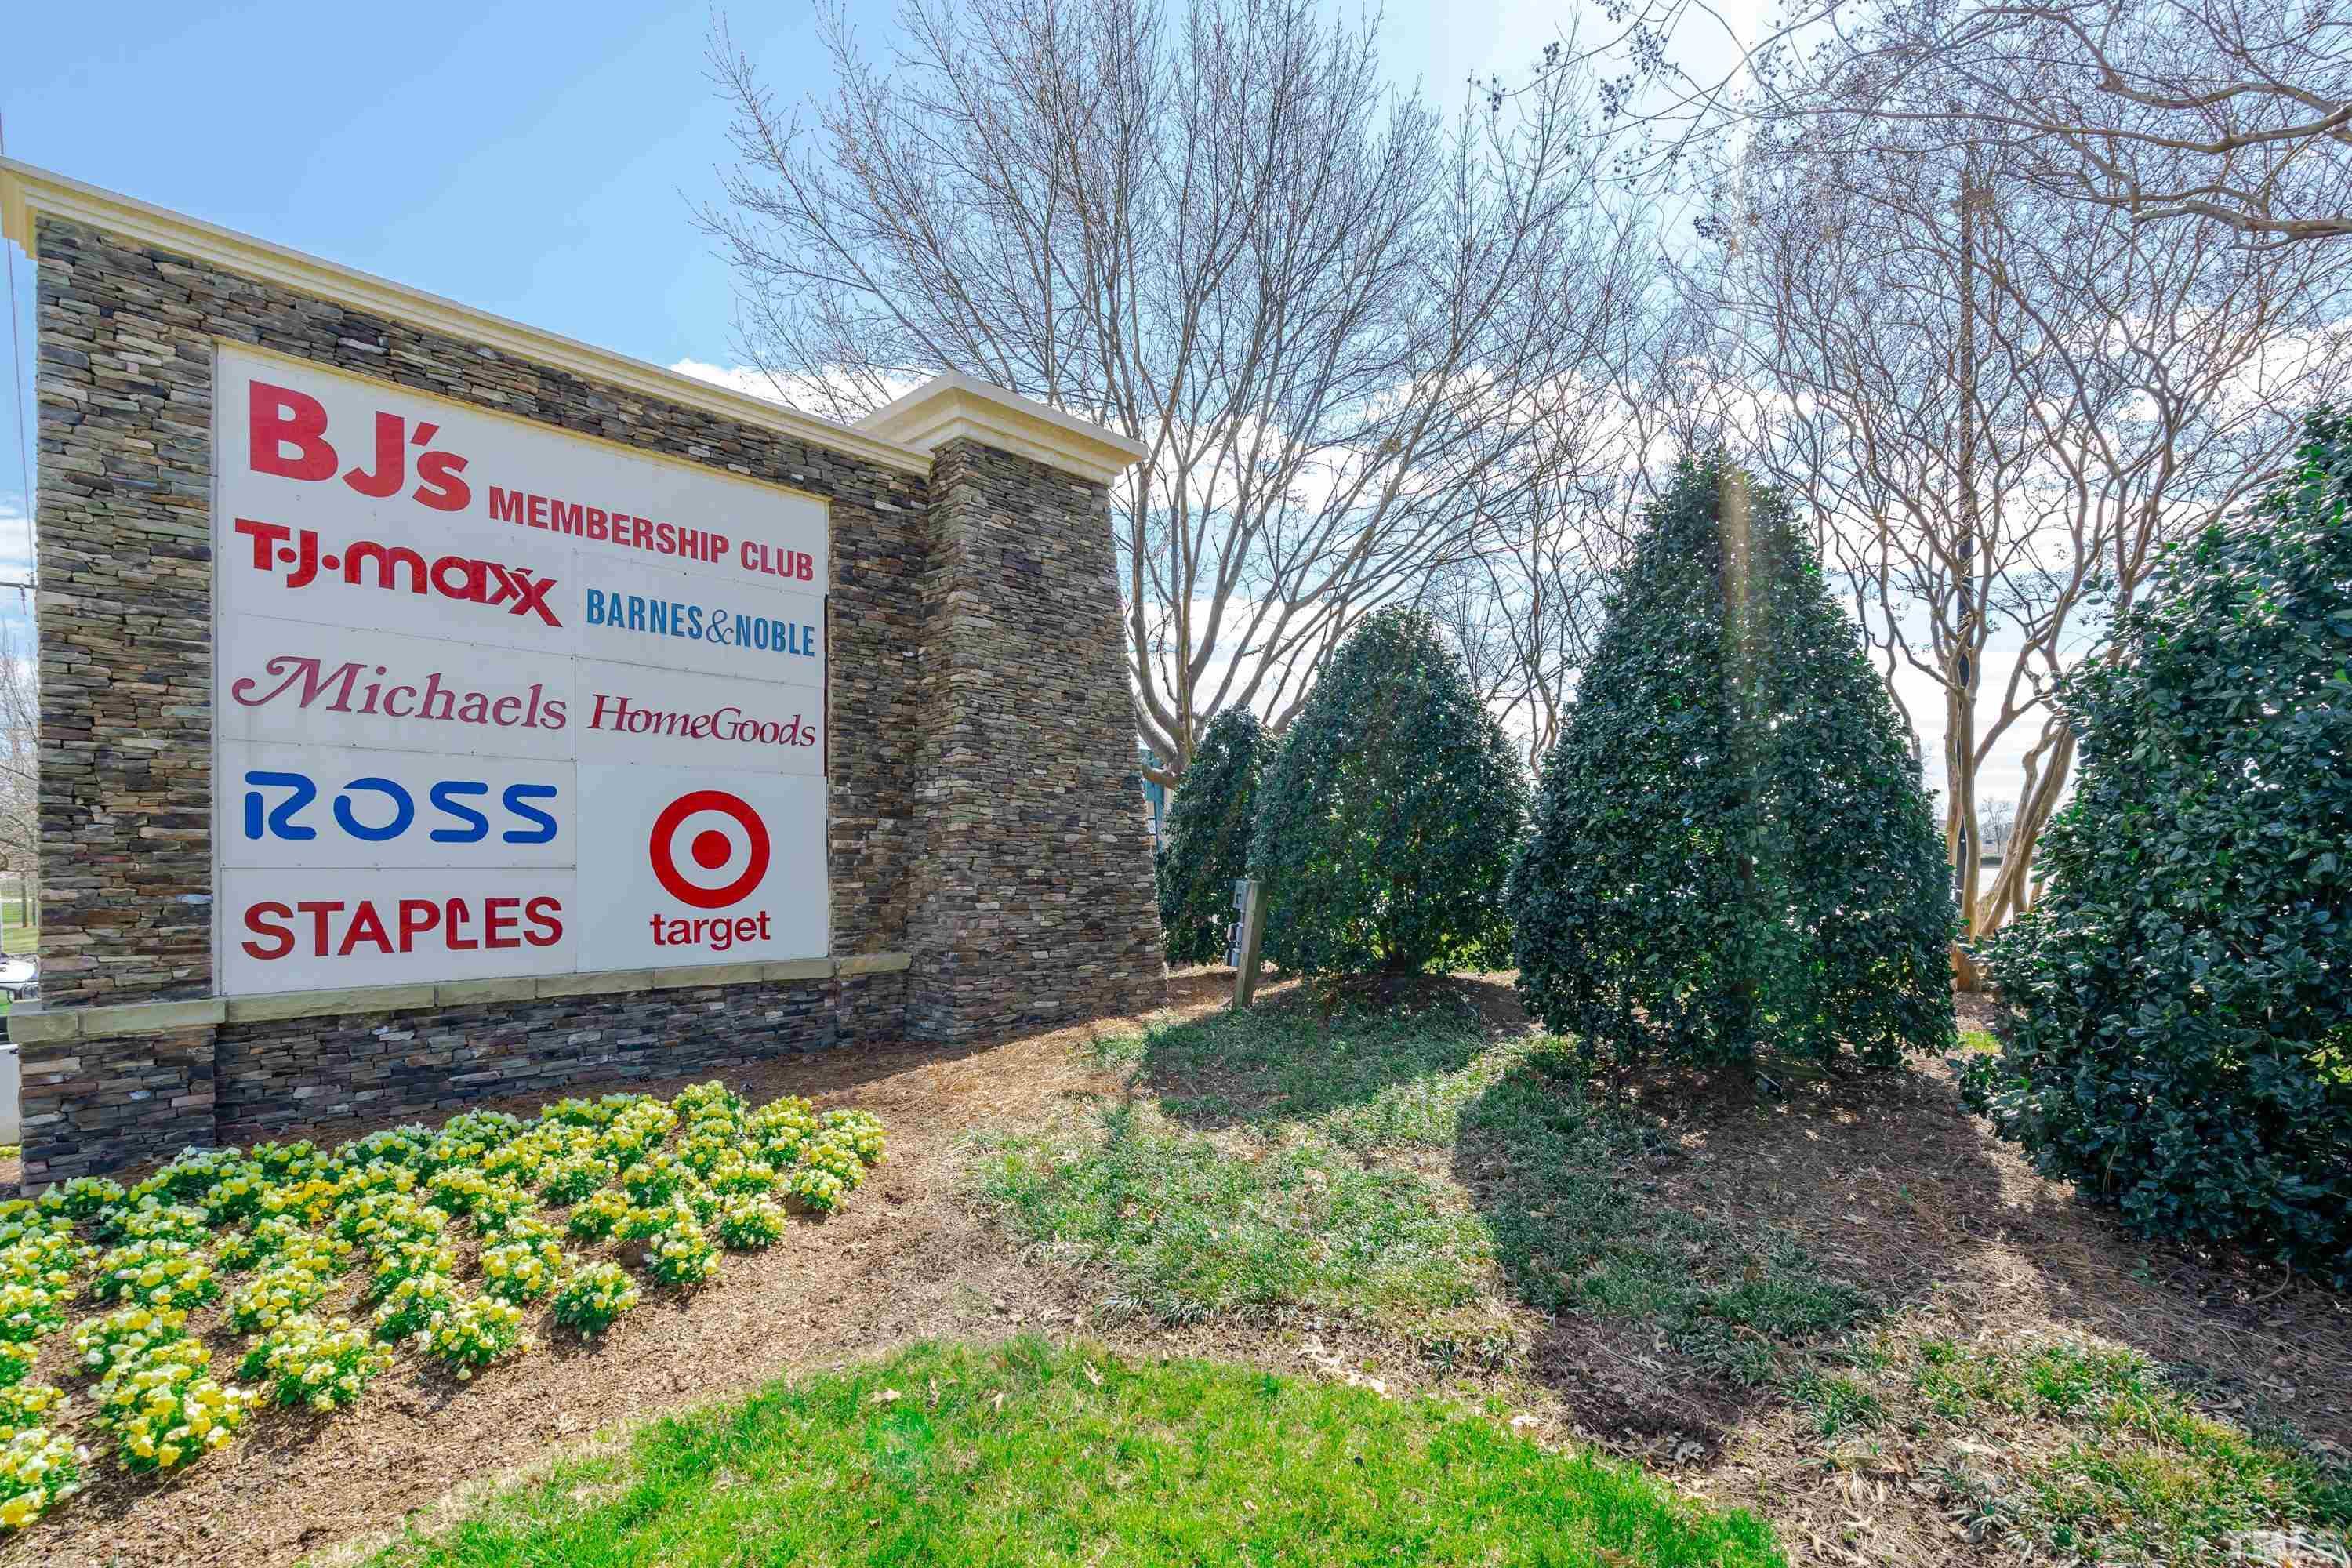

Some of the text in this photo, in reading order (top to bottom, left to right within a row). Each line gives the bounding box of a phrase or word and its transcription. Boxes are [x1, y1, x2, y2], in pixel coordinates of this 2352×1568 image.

[249, 379, 472, 512] BJ's
[488, 485, 814, 582] MEMBERSHIP CLUB
[231, 655, 567, 731] Michaels
[586, 693, 816, 747] HomeGoods
[244, 771, 558, 844] ROSS
[241, 895, 564, 960] STAPLES
[649, 910, 771, 951] target
